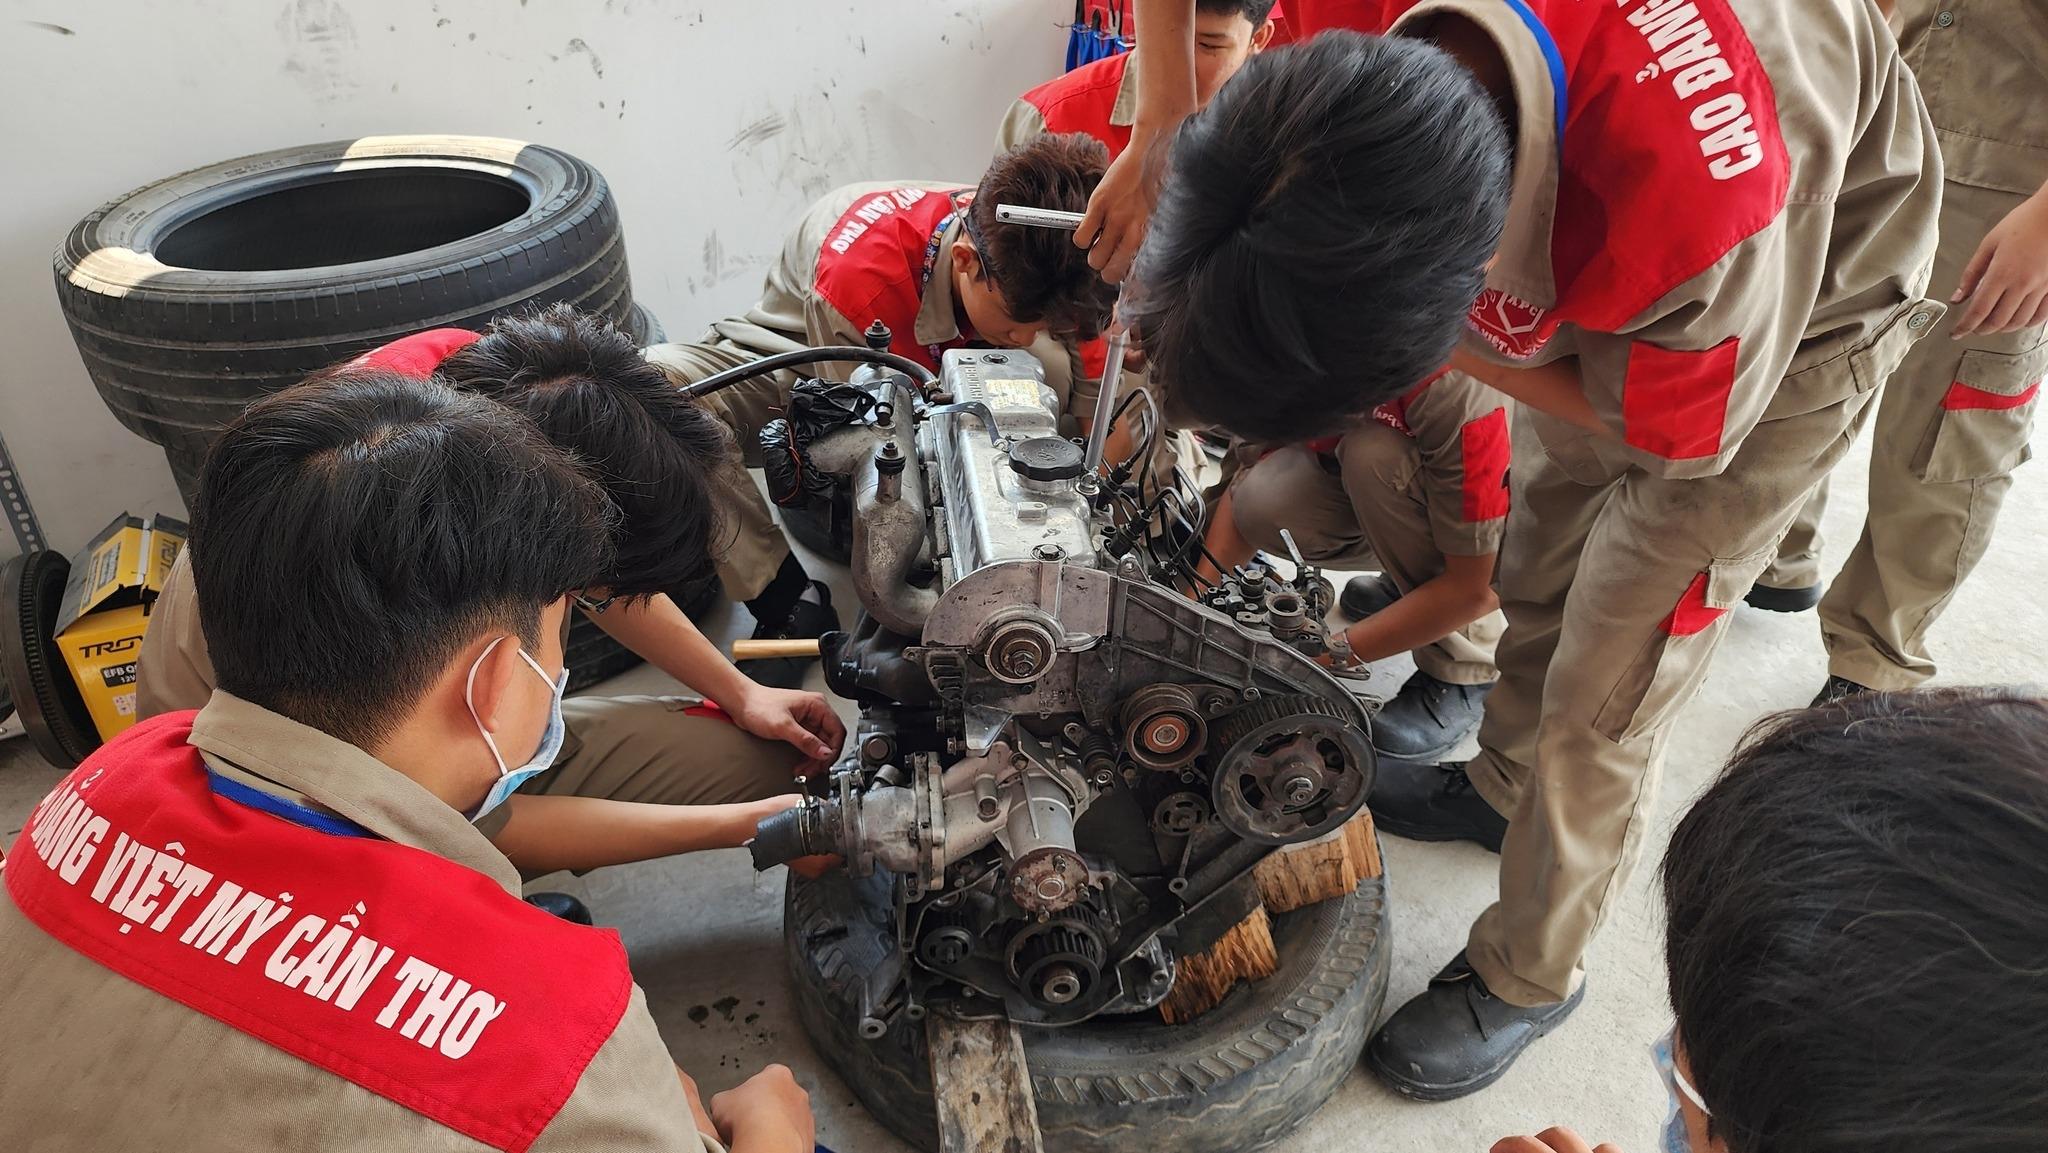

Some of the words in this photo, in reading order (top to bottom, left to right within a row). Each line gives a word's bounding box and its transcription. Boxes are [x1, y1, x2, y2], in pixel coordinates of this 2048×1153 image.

[1689, 92, 1764, 181] CAO
[829, 220, 869, 255] THƠ
[79, 635, 143, 658] TRO
[104, 667, 125, 679] EFB
[90, 831, 215, 935] VIỆT
[179, 880, 295, 965] MỸ
[264, 900, 396, 1012] CẦN
[374, 955, 507, 1060] THƠ
